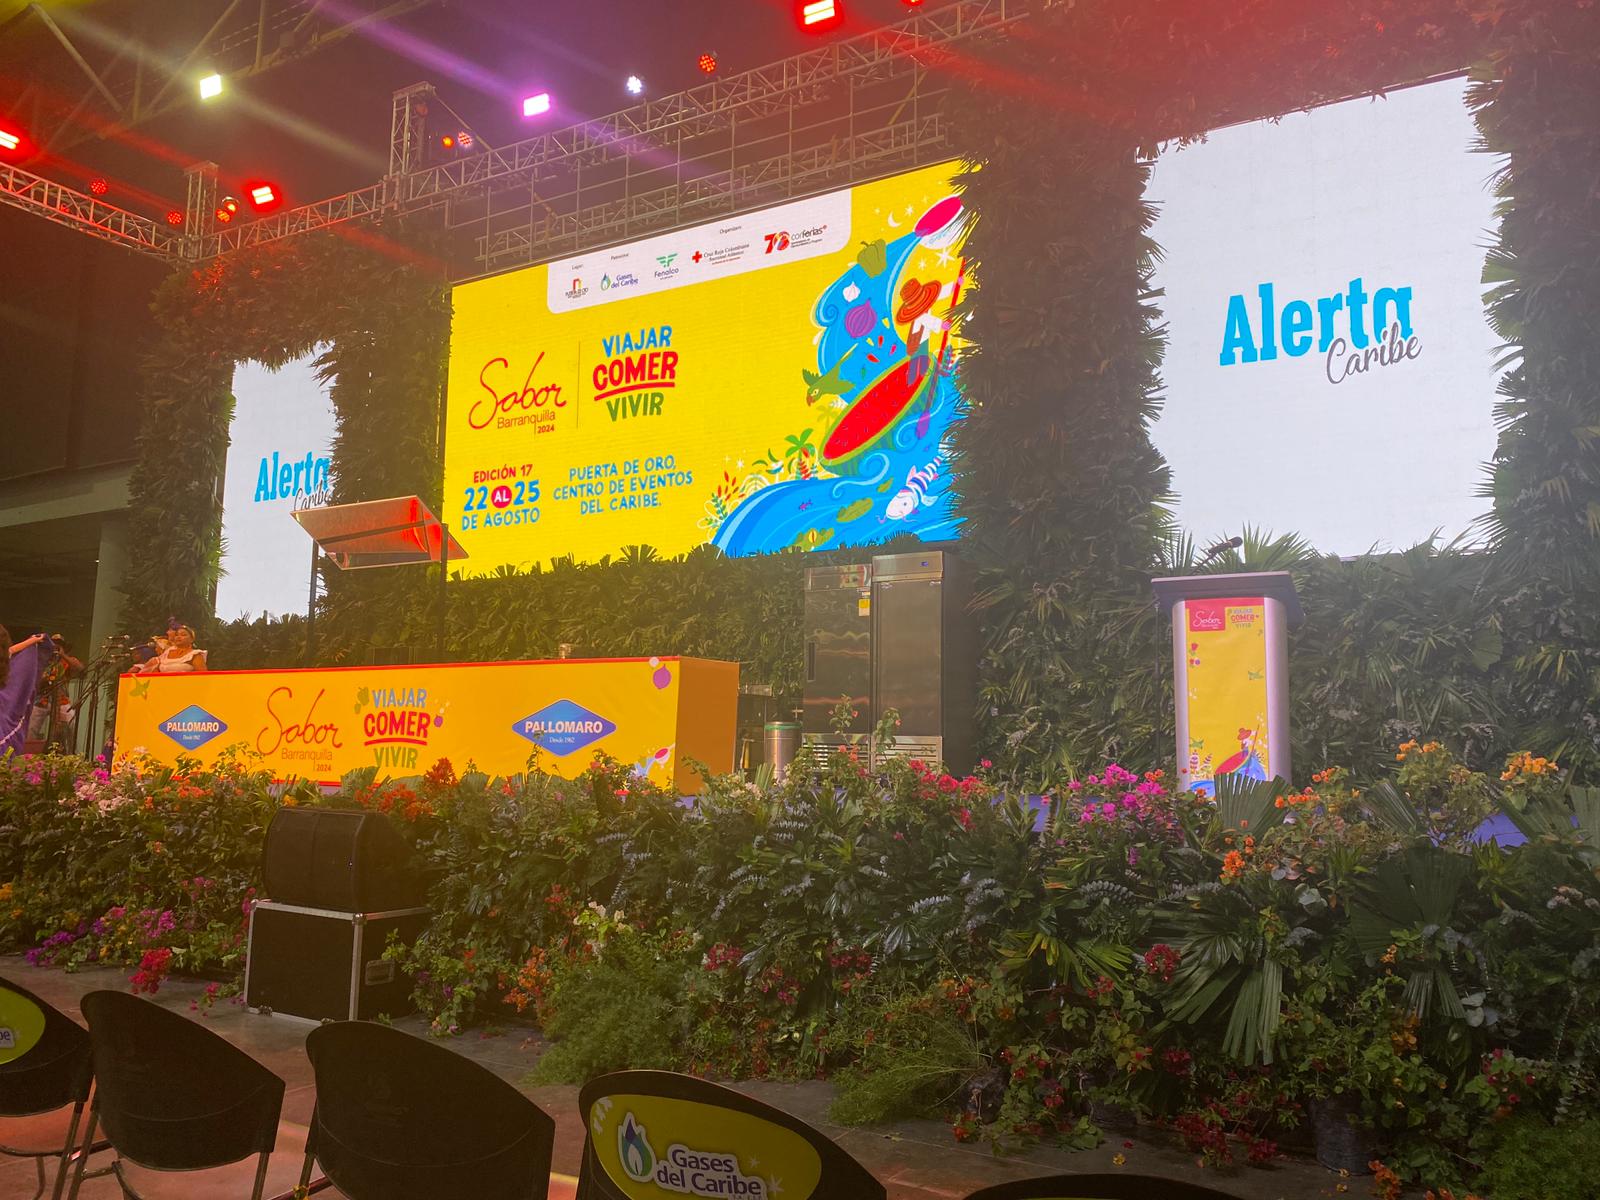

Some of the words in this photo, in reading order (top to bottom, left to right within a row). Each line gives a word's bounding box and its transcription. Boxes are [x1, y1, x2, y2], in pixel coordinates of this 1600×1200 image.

[1219, 277, 1413, 366] Alerta
[602, 326, 672, 358] VIAJAR
[1326, 321, 1423, 384] Caribe
[592, 351, 679, 391] COMER
[468, 352, 567, 430] Sabor
[497, 410, 556, 430] Barranquilla
[606, 392, 664, 422] VIVIR
[537, 424, 555, 434] 2024
[254, 451, 330, 502] Alerta
[474, 464, 516, 484] EDICIÓN
[520, 464, 533, 478] 17
[569, 462, 618, 482] PUERTA
[624, 460, 639, 476] DE
[644, 454, 676, 472] ORO,
[464, 486, 488, 512] 22
[494, 489, 510, 504] AL
[513, 479, 540, 506] 25
[553, 482, 604, 500] CENTRO
[609, 479, 625, 495] DE
[630, 470, 693, 492] EVENTOS
[580, 499, 604, 515] DEL
[610, 492, 662, 510] CARIBE.
[462, 514, 478, 530] DE
[484, 508, 540, 528] AGOSTO
[372, 688, 428, 708] VIAJAR
[166, 722, 220, 733] PALLOMARO
[256, 686, 343, 756] Sabor
[364, 710, 432, 738] COMER
[524, 720, 603, 734] PALLOMARO
[282, 748, 332, 762] Barranquilla
[316, 764, 332, 772] 2024
[373, 746, 419, 770] VIVIR
[671, 1149, 734, 1173] Gases
[657, 1166, 686, 1188] del
[691, 1172, 761, 1196] Caribe
